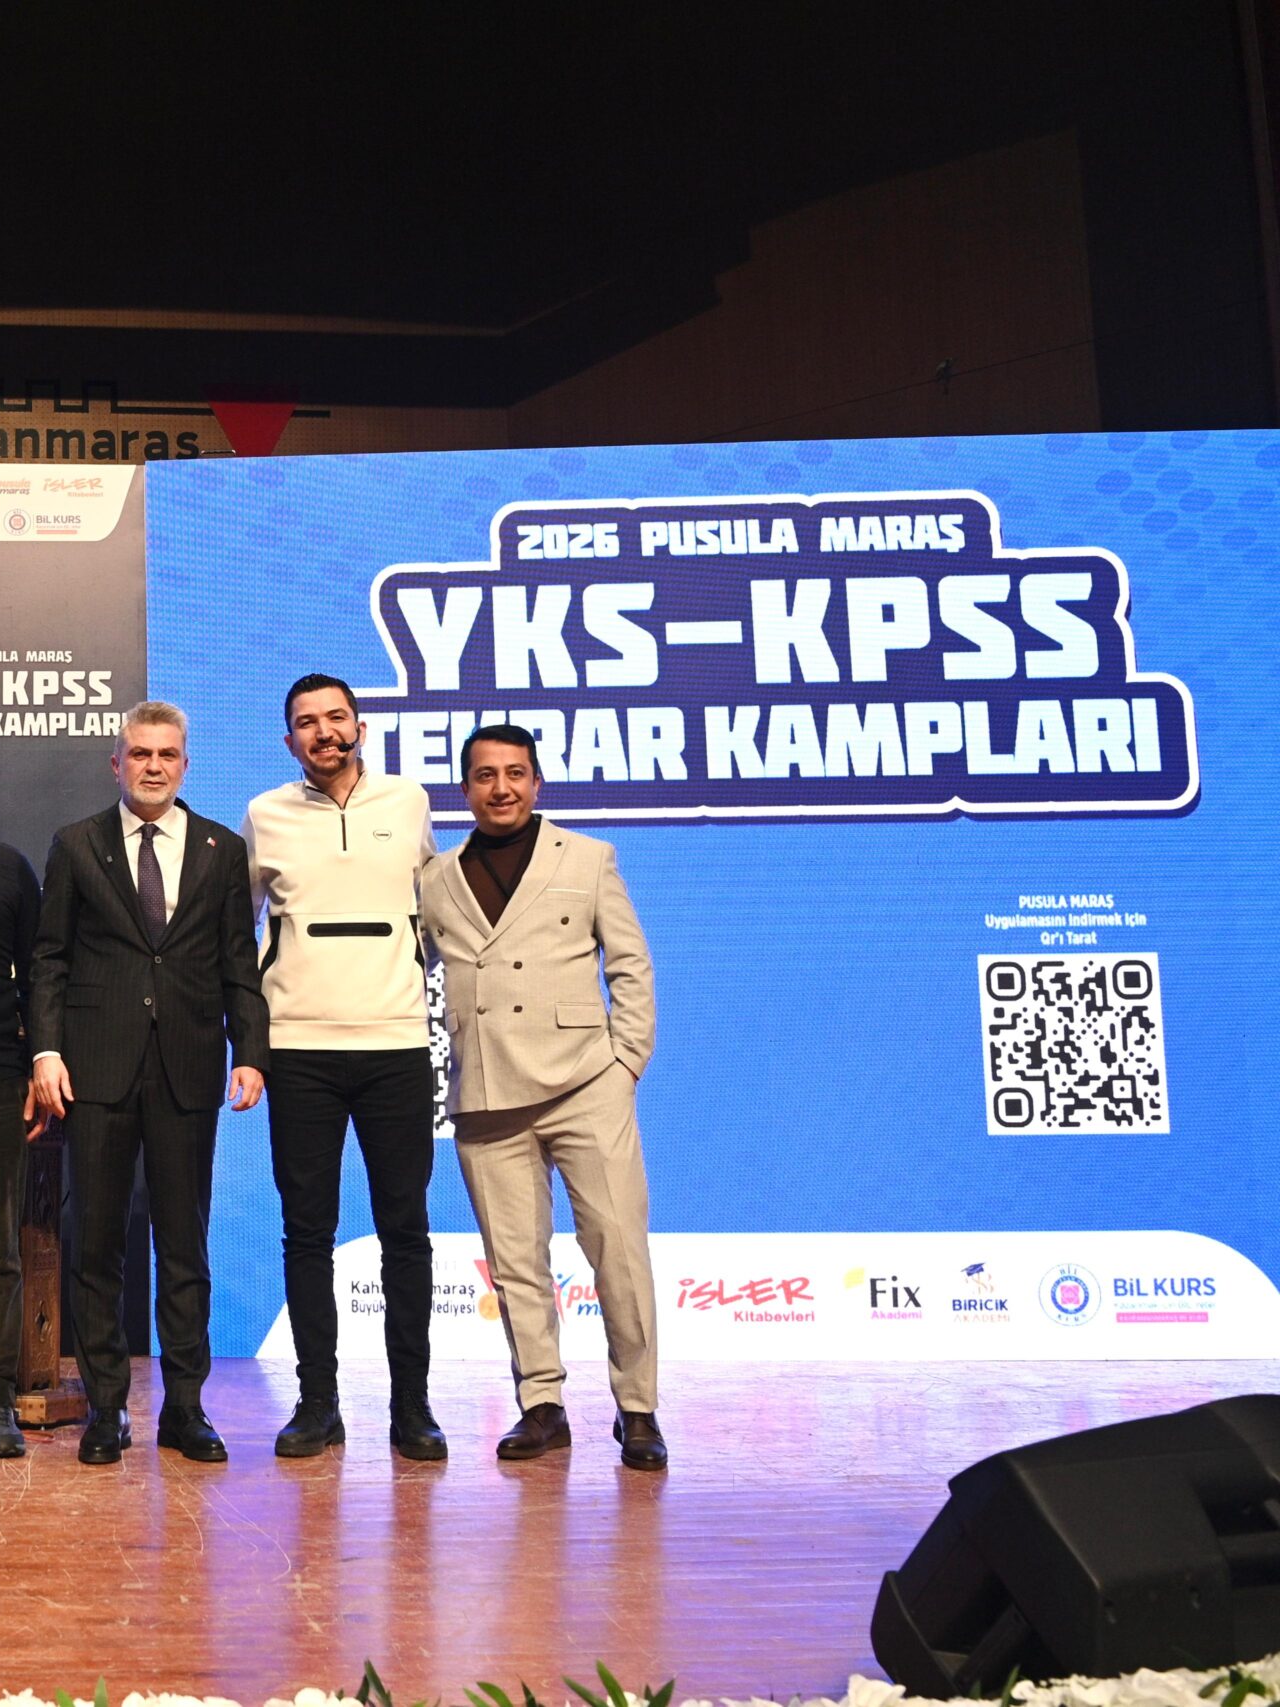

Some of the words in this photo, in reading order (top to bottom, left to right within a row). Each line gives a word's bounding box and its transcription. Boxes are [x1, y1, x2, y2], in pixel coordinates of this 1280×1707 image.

[53, 515, 81, 524] KURS
[517, 522, 620, 560] 2026
[641, 517, 798, 556] PUSULA
[820, 514, 966, 553] MARAŞ
[26, 651, 73, 664] MARAŞ
[706, 698, 1162, 779] KAMPLARI
[1019, 895, 1067, 909] PUSULA
[1070, 894, 1114, 909] MARAŞ
[1065, 931, 1097, 945] Tarat
[351, 1281, 475, 1298] Kahmaraş
[870, 1275, 922, 1308] Fix
[1153, 1277, 1216, 1296] KURS
[432, 1300, 475, 1317] lediyesi
[734, 1310, 815, 1323] Kitabevleri
[871, 1310, 922, 1320] Akademi
